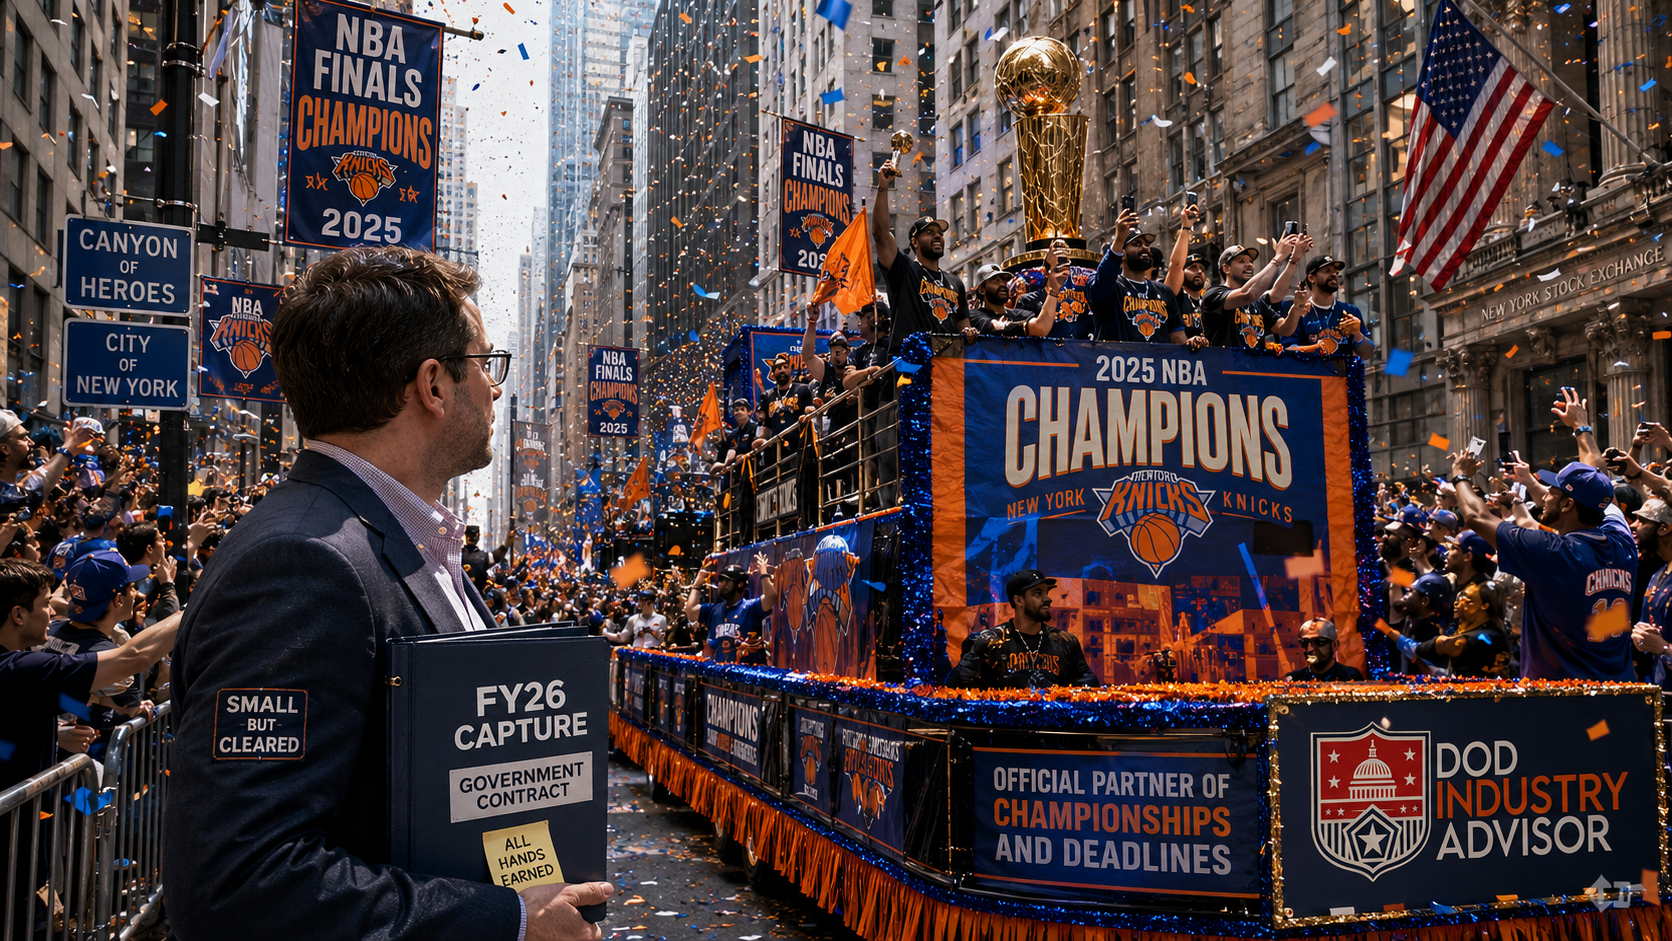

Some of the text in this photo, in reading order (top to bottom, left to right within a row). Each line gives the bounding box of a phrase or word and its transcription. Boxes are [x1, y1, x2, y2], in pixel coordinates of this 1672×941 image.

[336, 13, 406, 64] NBA
[313, 49, 422, 108] FINALS
[297, 95, 432, 169] CHAMPIONS
[803, 130, 836, 161] NBA
[793, 152, 843, 188] FINALS
[784, 179, 850, 226] CHAMPIONS
[321, 208, 402, 244] 2025
[79, 228, 178, 259] CANYON
[798, 249, 827, 270] 202
[119, 260, 139, 274] OF
[81, 276, 175, 305] HEROES
[1481, 245, 1665, 322] NEW YORK STOCK EXCHANGE
[231, 297, 263, 316] NBA
[106, 333, 151, 353] CITY
[602, 350, 626, 366] NBA
[119, 357, 138, 372] OF
[595, 364, 633, 382] FINALS
[1096, 355, 1207, 386] 2025 NBA
[76, 376, 179, 398] NEW YORK
[590, 380, 638, 405] CHAMPIONS
[599, 422, 628, 434] 2025
[1004, 384, 1292, 491] CHAMPIONS
[1007, 488, 1085, 522] NEW YORK
[1100, 480, 1210, 524] KNICKS
[1223, 491, 1293, 523] KNICKS
[226, 695, 299, 714] SMALL
[476, 679, 566, 717] FY26
[454, 712, 588, 751] CAPTURE
[706, 694, 759, 742] CHAMPIONS
[219, 736, 300, 753] CLEARED
[1436, 740, 1518, 779] DOD
[459, 762, 584, 794] GOVERNMENT
[993, 766, 1230, 798] OFFICIAL PARTNER OF
[476, 782, 570, 810] CONTRACT
[1436, 771, 1629, 819] INDUSTRY
[993, 797, 1232, 837] CHAMPIONSHIPS
[505, 835, 532, 852] ALL
[1436, 814, 1613, 861] ADVISOR
[498, 848, 546, 870] HANDS
[995, 833, 1232, 876] AND DEADLINES
[500, 864, 554, 888] EARNED
